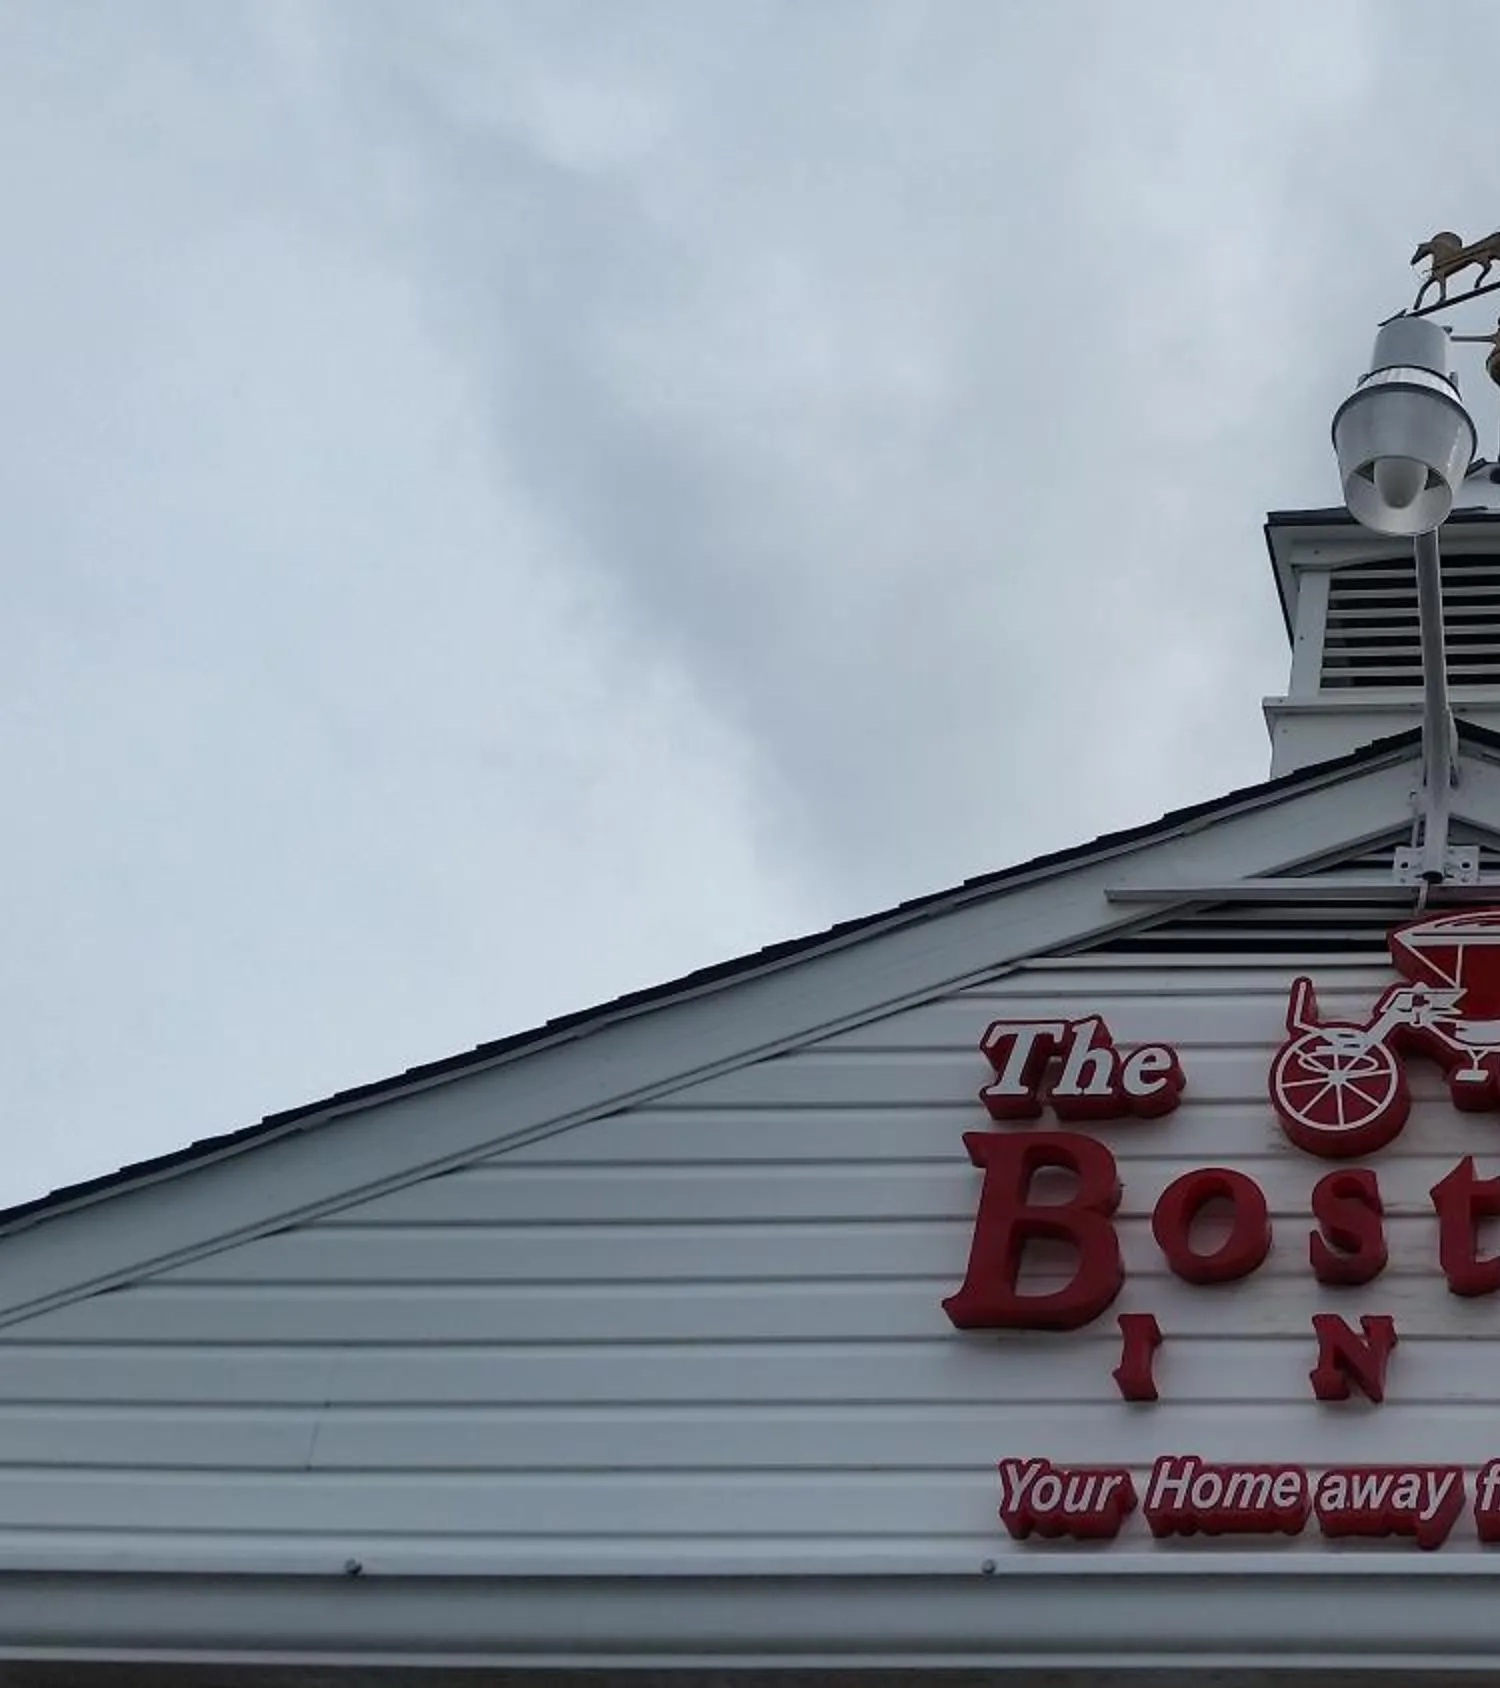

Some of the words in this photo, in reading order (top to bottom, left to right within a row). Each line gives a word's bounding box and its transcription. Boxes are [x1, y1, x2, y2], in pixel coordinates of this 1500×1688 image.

[984, 1018, 1173, 1097] The
[1004, 1461, 1123, 1515] Your
[1147, 1459, 1301, 1512] Home
[1317, 1465, 1457, 1522] away
